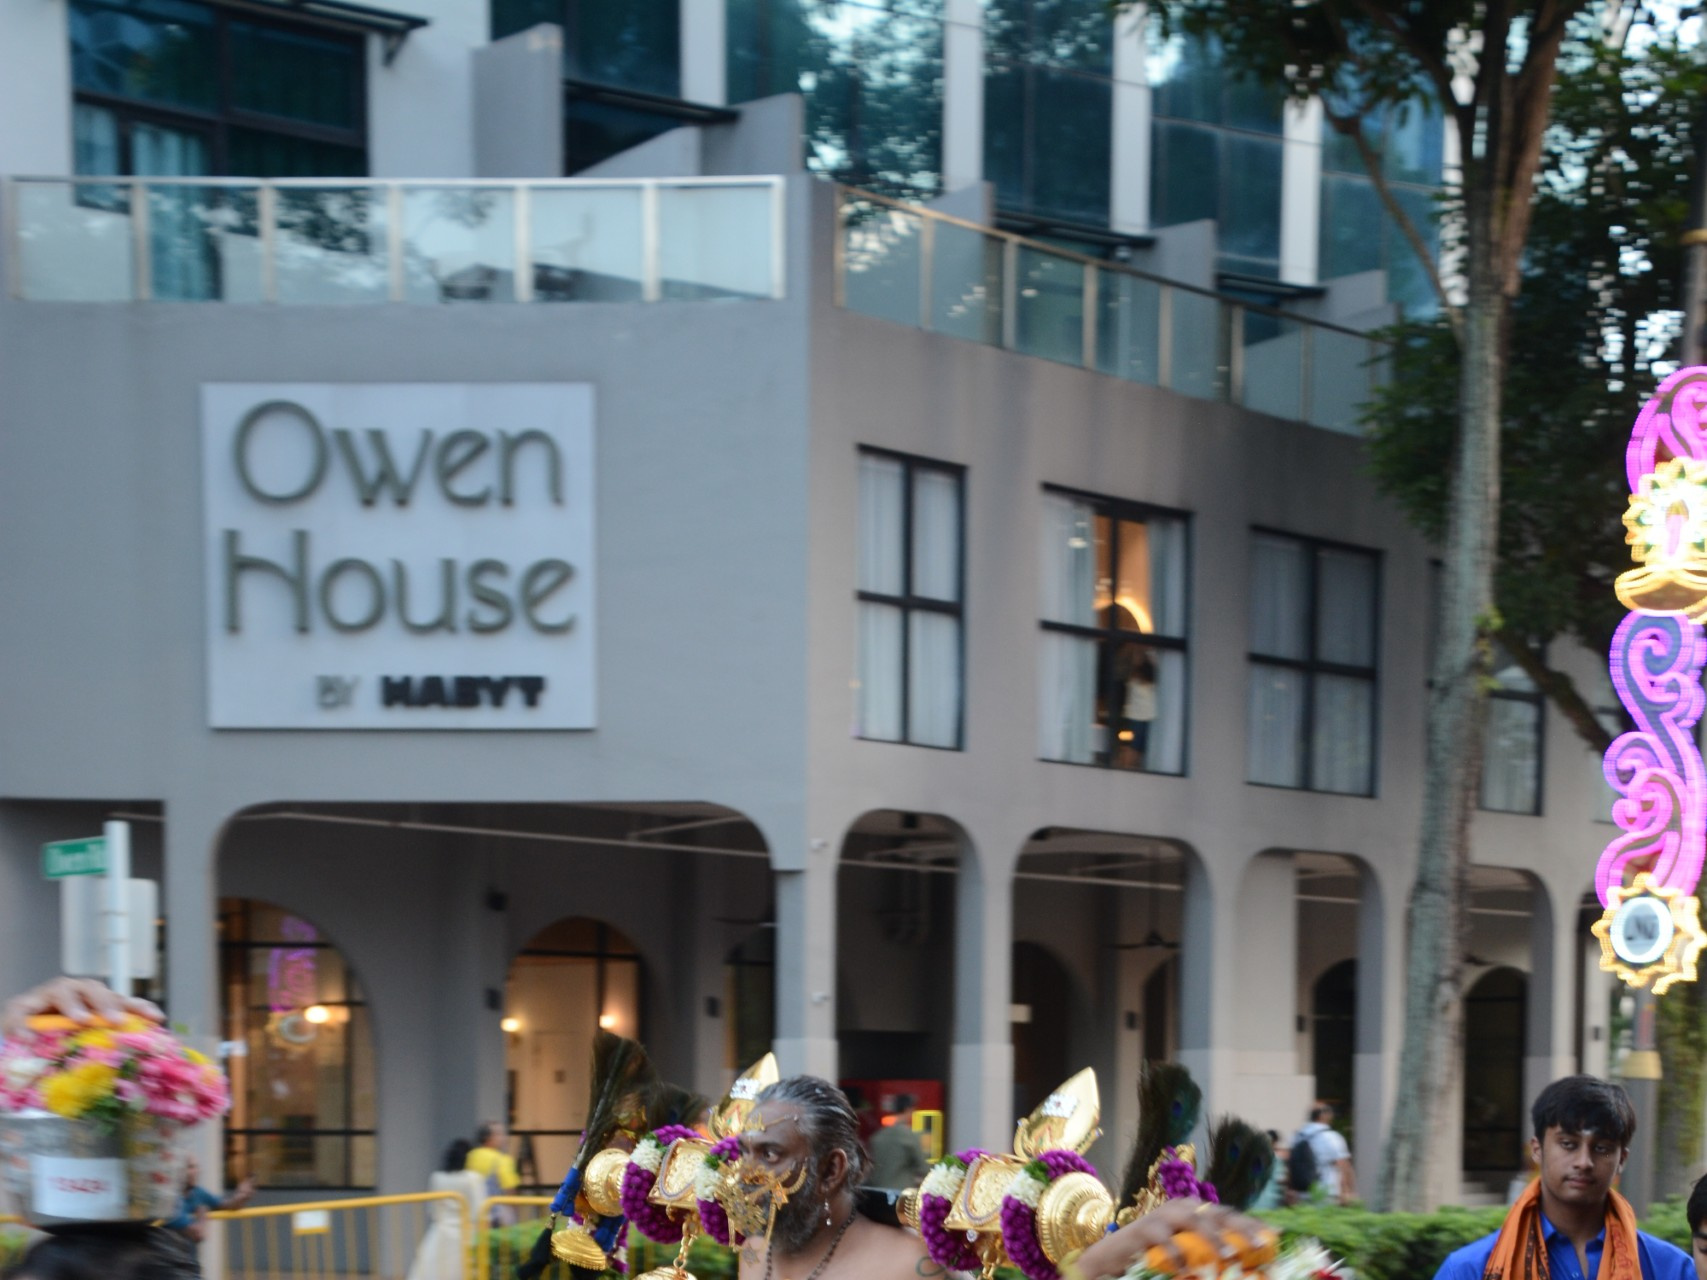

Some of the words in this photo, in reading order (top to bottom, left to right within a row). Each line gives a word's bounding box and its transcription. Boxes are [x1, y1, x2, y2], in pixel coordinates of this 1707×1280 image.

[232, 399, 564, 508] Owen
[221, 528, 577, 636] House
[314, 675, 357, 709] BY
